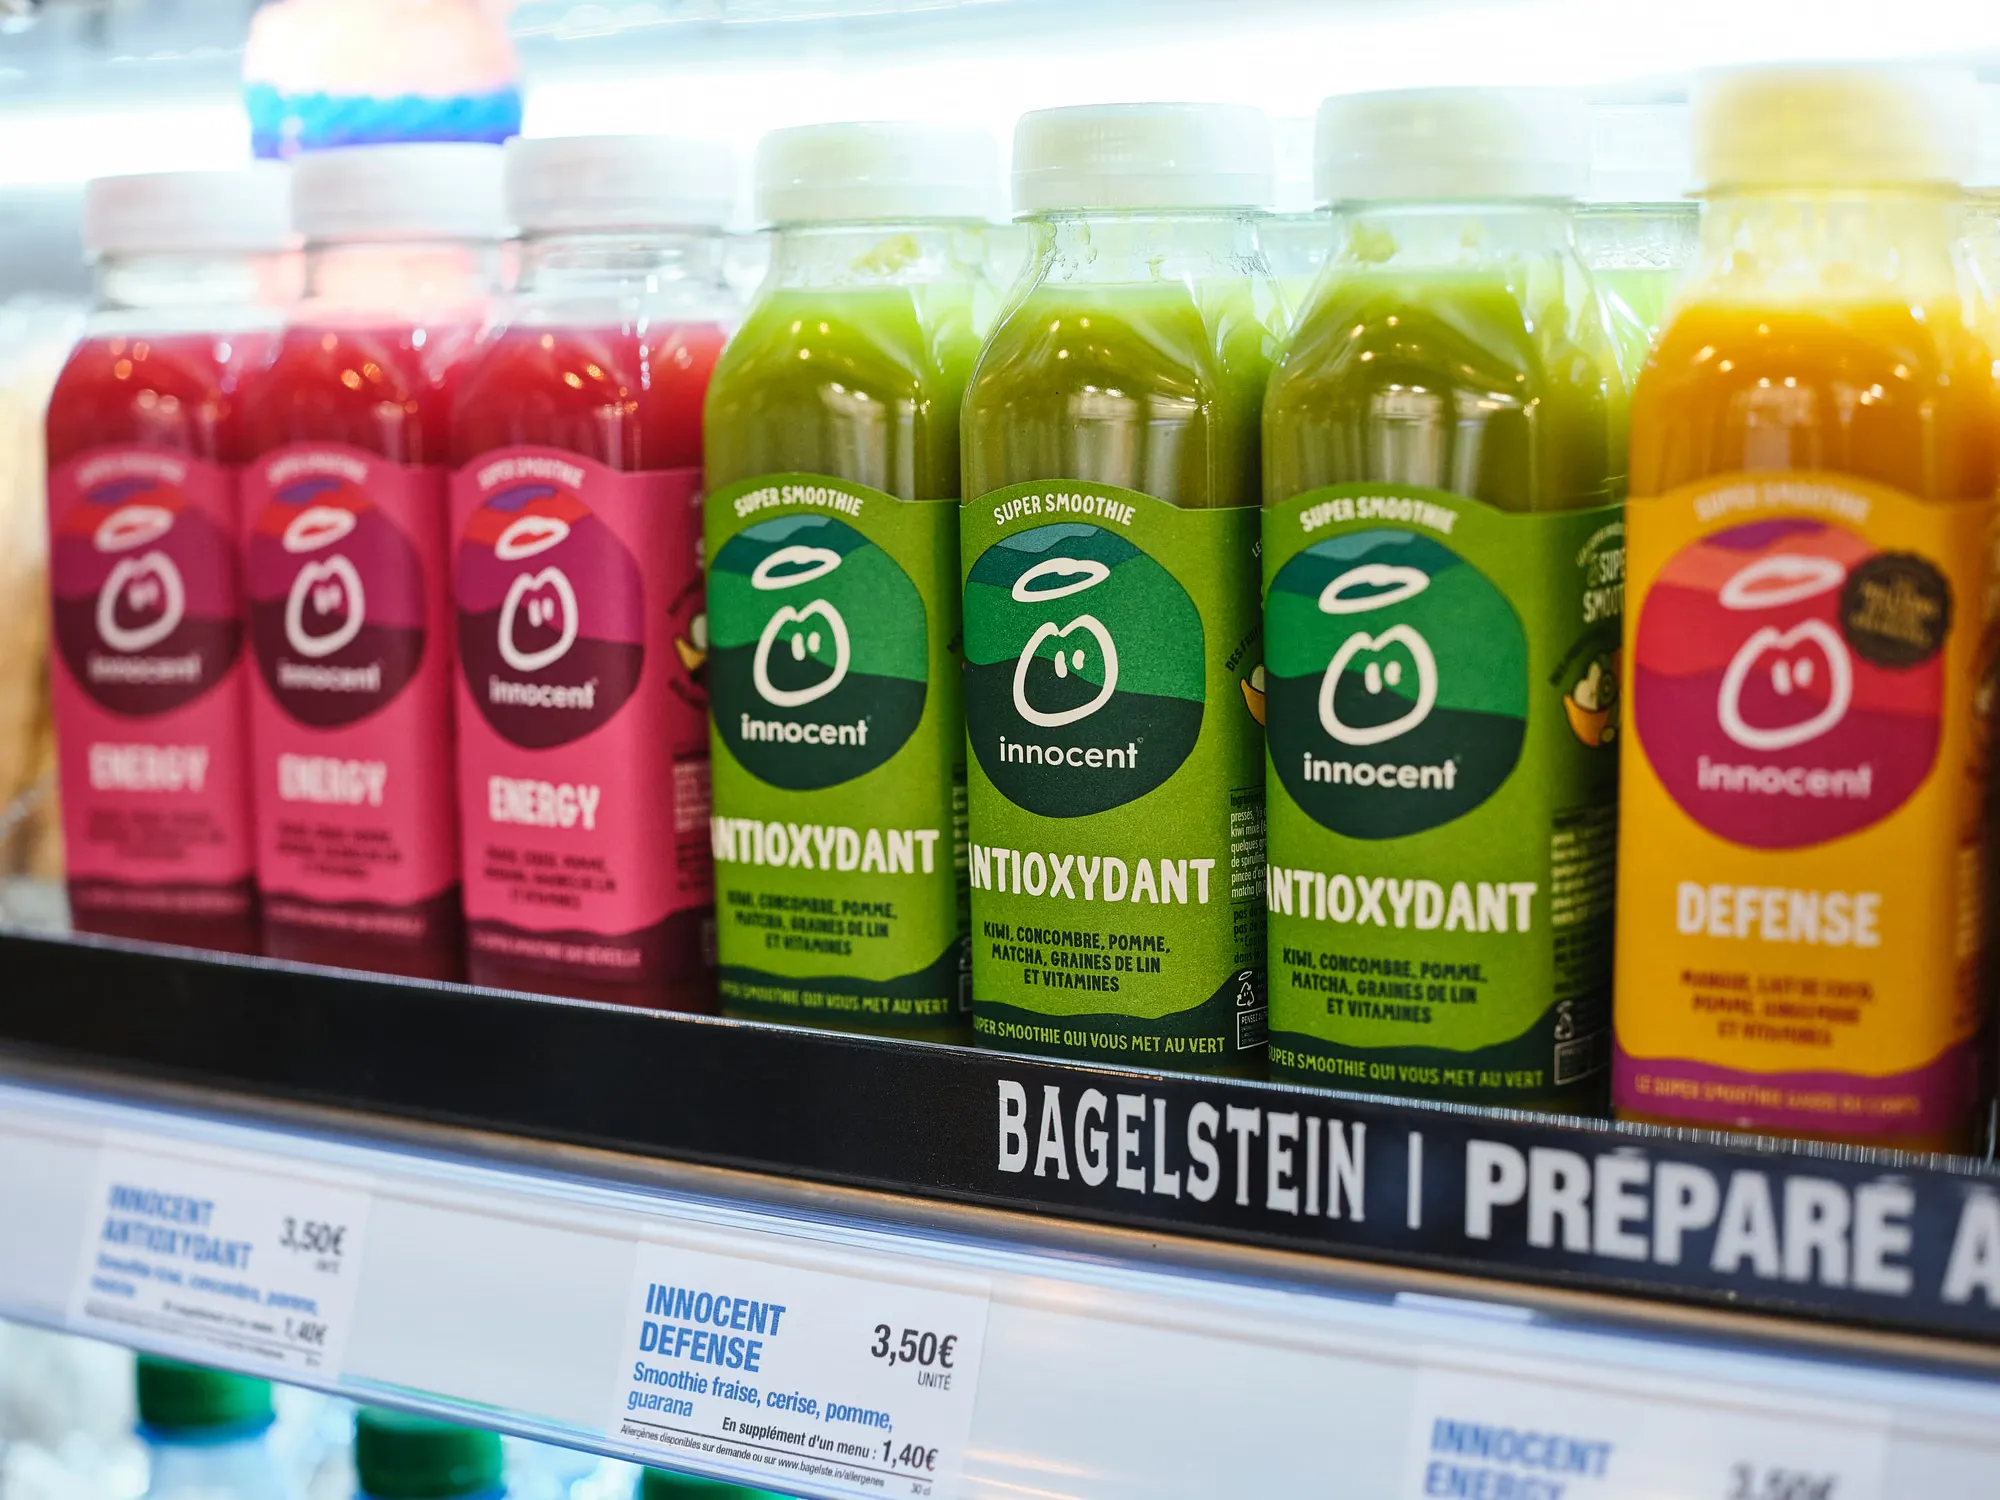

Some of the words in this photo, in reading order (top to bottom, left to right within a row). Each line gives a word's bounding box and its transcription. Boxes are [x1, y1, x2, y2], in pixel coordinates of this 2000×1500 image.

[733, 487, 780, 518] SUPER
[782, 486, 864, 517] SMOOTHIE
[993, 494, 1041, 525] SUPER
[1045, 494, 1136, 526] SMOOTHIE
[1300, 498, 1354, 533] SUPER
[1357, 496, 1458, 534] SMOOTHIE
[488, 675, 595, 709] innocent
[741, 713, 868, 745] innocent
[999, 736, 1138, 769] innocent
[1303, 752, 1457, 790] innocent
[1697, 755, 1872, 798] innocent
[488, 775, 600, 831] ENERGY
[1230, 820, 1245, 838] kiwi
[1231, 838, 1258, 855] quelques
[1231, 855, 1240, 868] de
[968, 841, 1216, 904] NTIOXYDANT
[1232, 882, 1254, 898] matcha
[842, 901, 897, 920] POMME,
[1234, 909, 1247, 923] pas
[1676, 880, 1882, 947] DEFENSE
[765, 933, 780, 949] ET
[848, 921, 864, 936] DE
[867, 922, 889, 937] LIN
[984, 921, 1014, 942] KIWI,
[1017, 928, 1105, 951] CONCOMBRE,
[1109, 934, 1171, 954] POMME,
[1234, 923, 1247, 937] pas
[991, 944, 1048, 967] MATCHA,
[1051, 951, 1112, 972] GRAINES
[1115, 955, 1133, 972] DE
[1137, 956, 1161, 974] LIN
[1283, 947, 1316, 969] KIWI,
[1320, 952, 1417, 979] CONCOMBRE,
[1421, 961, 1487, 983] POMME,
[1024, 969, 1040, 985] ET
[1043, 971, 1120, 993] VITAMINES
[1292, 971, 1353, 996] MATCHA,
[1356, 979, 1424, 1002] GRAINES
[1427, 984, 1447, 1003] DE
[1451, 985, 1477, 1005] LIN
[825, 992, 860, 1011] VOUS
[861, 996, 889, 1013] MET
[891, 998, 911, 1014] AU
[912, 998, 949, 1015] VERT
[1327, 998, 1343, 1016] ET
[1349, 1000, 1432, 1024] VITAMINES
[973, 1014, 996, 1035] UPER
[998, 1022, 1060, 1045] SMOOTHIE
[1063, 1029, 1087, 1047] QUI
[1090, 1032, 1127, 1051] VOUS
[1131, 1036, 1161, 1053] MET
[1165, 1037, 1187, 1053] AU
[1189, 1037, 1225, 1054] VERT
[1297, 1053, 1365, 1078] SMOOTHIE
[1370, 1062, 1395, 1081] QUI
[1398, 1065, 1439, 1085] VOUS
[1442, 1069, 1475, 1087] MET
[1479, 1070, 1501, 1087] AU
[1505, 1070, 1544, 1088] VERT
[998, 1079, 1366, 1222] BAGELSTEIN
[1465, 1143, 1915, 1296] PRÉPARÉ
[109, 1183, 215, 1227] INNOCENT
[279, 1216, 347, 1256] 3,50€
[645, 1283, 786, 1336] INNOCENT
[640, 1321, 763, 1373] DEFENSE
[871, 1324, 957, 1368] 3,50€
[633, 1361, 708, 1394] Smoothie
[712, 1376, 761, 1407] fraise,
[766, 1391, 820, 1420] cerise,
[825, 1401, 893, 1432] pomme,
[917, 1371, 952, 1391] UNITÉ
[627, 1391, 693, 1418] guarana
[620, 1424, 658, 1443] Allergènes
[659, 1431, 701, 1452] disponibles
[702, 1442, 714, 1453] sur
[715, 1444, 751, 1461] demande
[752, 1452, 762, 1462] ou
[763, 1455, 776, 1466] sur
[722, 1417, 737, 1433] En
[739, 1421, 806, 1449] supplément
[808, 1434, 835, 1451] d'un
[837, 1443, 871, 1459] menu
[882, 1440, 939, 1472] 1,40€
[1431, 1417, 1613, 1478] INNOCENT
